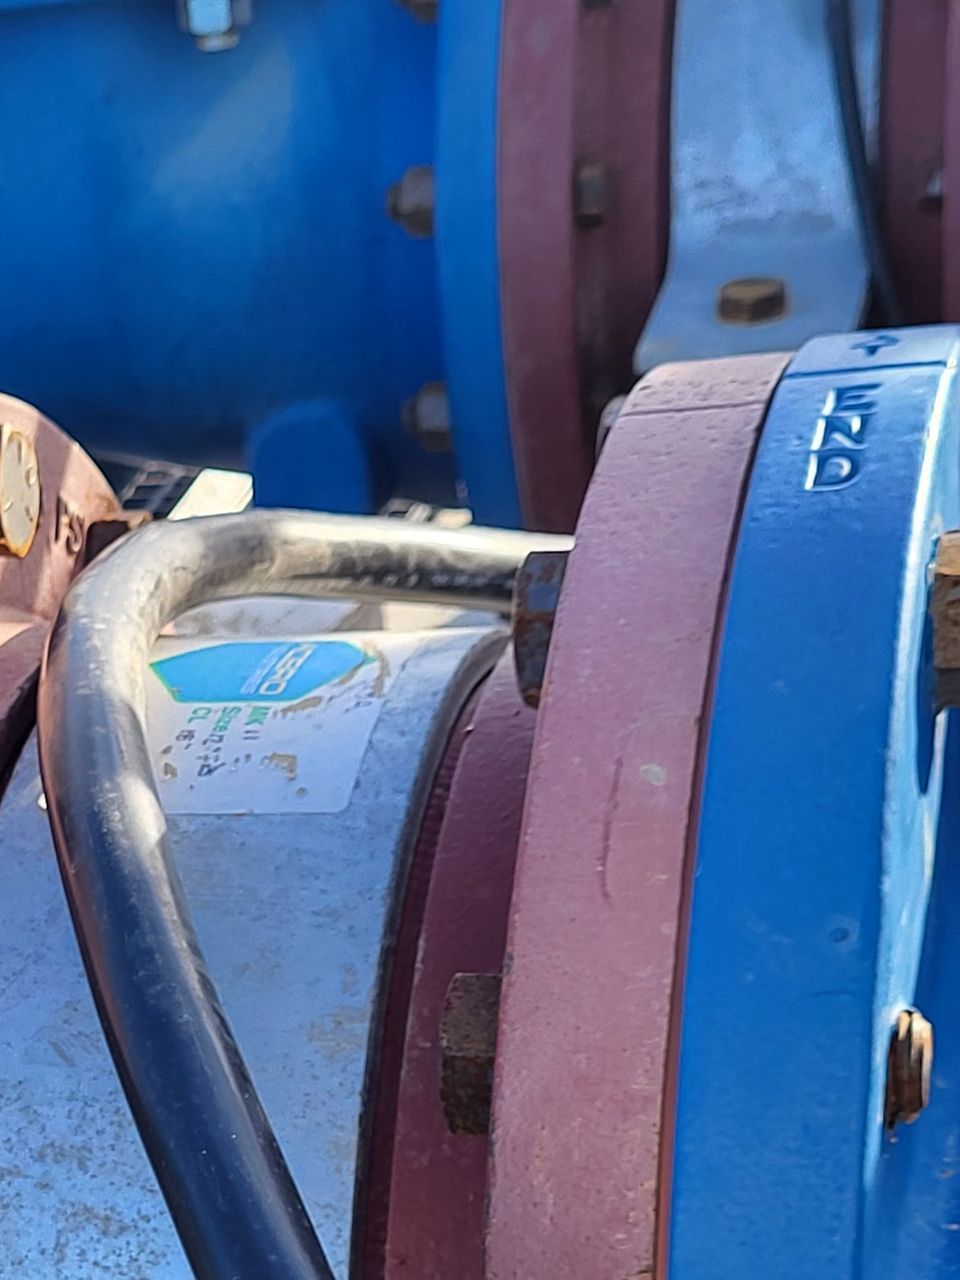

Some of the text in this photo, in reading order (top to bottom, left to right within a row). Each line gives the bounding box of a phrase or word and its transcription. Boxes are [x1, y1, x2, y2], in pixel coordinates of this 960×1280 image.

[803, 381, 884, 492] END
[186, 707, 213, 724] CL
[212, 706, 242, 732] Size
